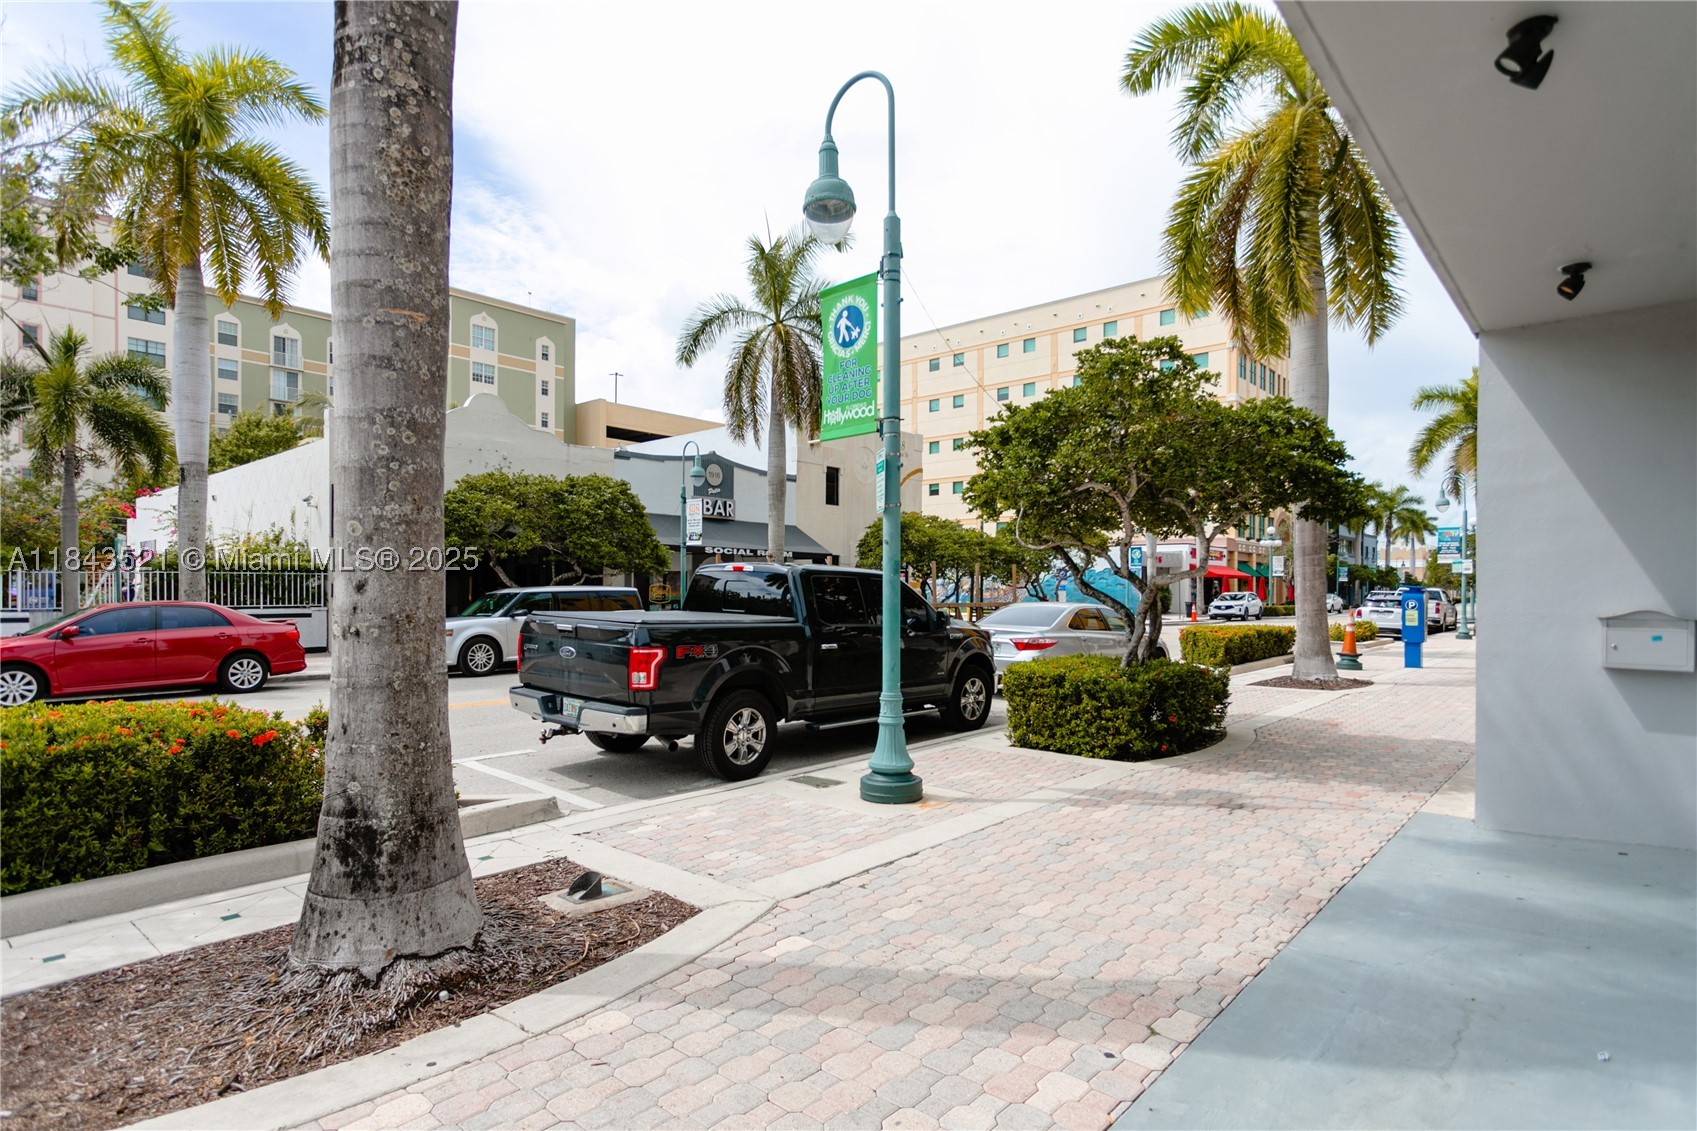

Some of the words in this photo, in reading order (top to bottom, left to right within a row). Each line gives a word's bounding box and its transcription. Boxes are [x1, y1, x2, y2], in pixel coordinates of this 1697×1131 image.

[840, 358, 857, 369] FOR
[828, 385, 839, 395] UP
[842, 378, 870, 391] AFTER
[827, 394, 850, 405] YOUR
[824, 400, 875, 425] Hollywood
[703, 499, 734, 517] BAR
[705, 546, 753, 556] SOCIAL
[757, 550, 793, 558] RM
[676, 644, 718, 659] FX4
